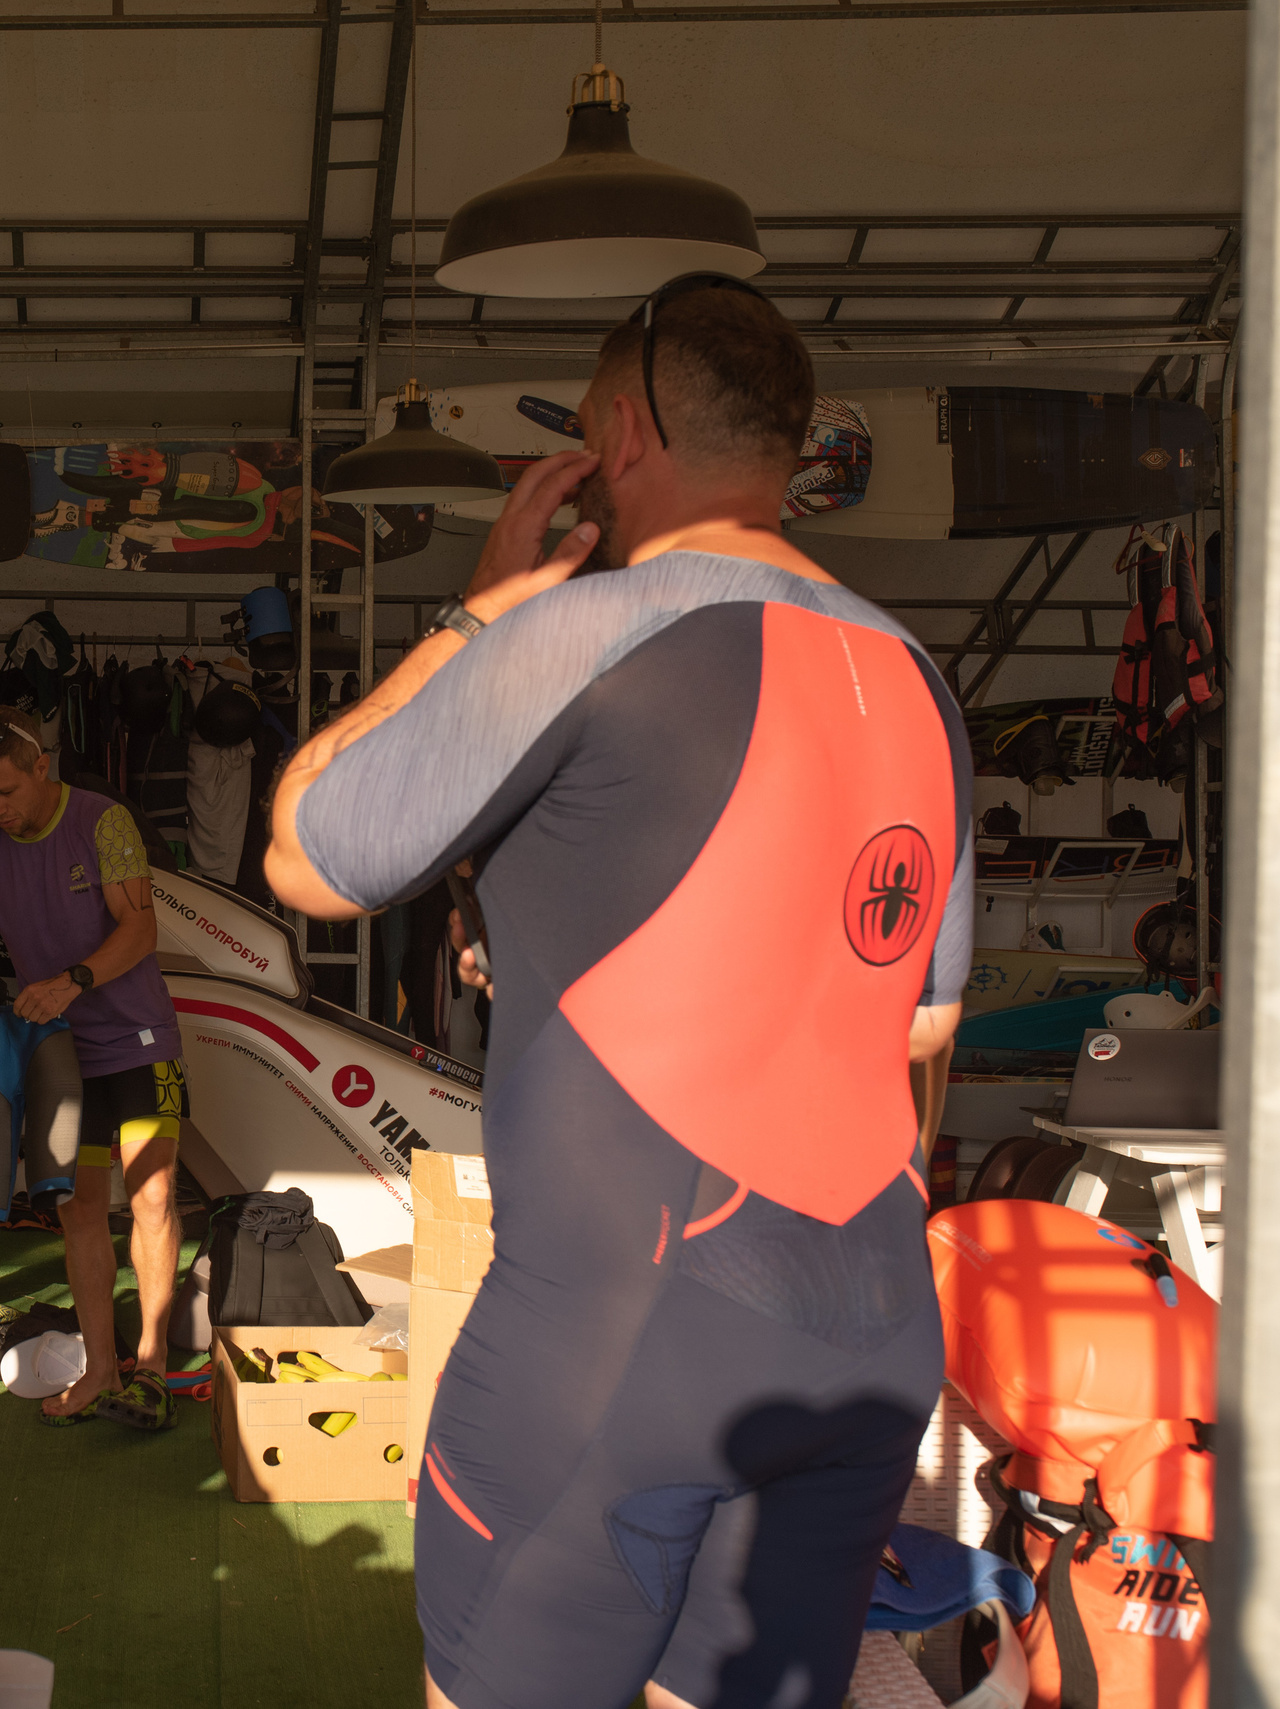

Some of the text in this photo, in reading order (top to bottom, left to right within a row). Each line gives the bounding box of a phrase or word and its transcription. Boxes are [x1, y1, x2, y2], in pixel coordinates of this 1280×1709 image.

[1082, 696, 1115, 777] SLNGSHOT
[196, 916, 270, 974] ПОПРОБУЙ
[425, 1052, 481, 1086] YAMAGUCHI
[195, 1033, 231, 1049] УКРЕПИ
[232, 1043, 285, 1080] ИММУНИТЕТ
[284, 1080, 312, 1107] СНИМИ
[310, 1104, 359, 1155] НАПРЯЖЕНИЕ
[357, 1152, 404, 1204] ВОССТАНОВИ
[369, 1099, 436, 1164] YAM
[378, 1145, 412, 1187] ТОЛЬК
